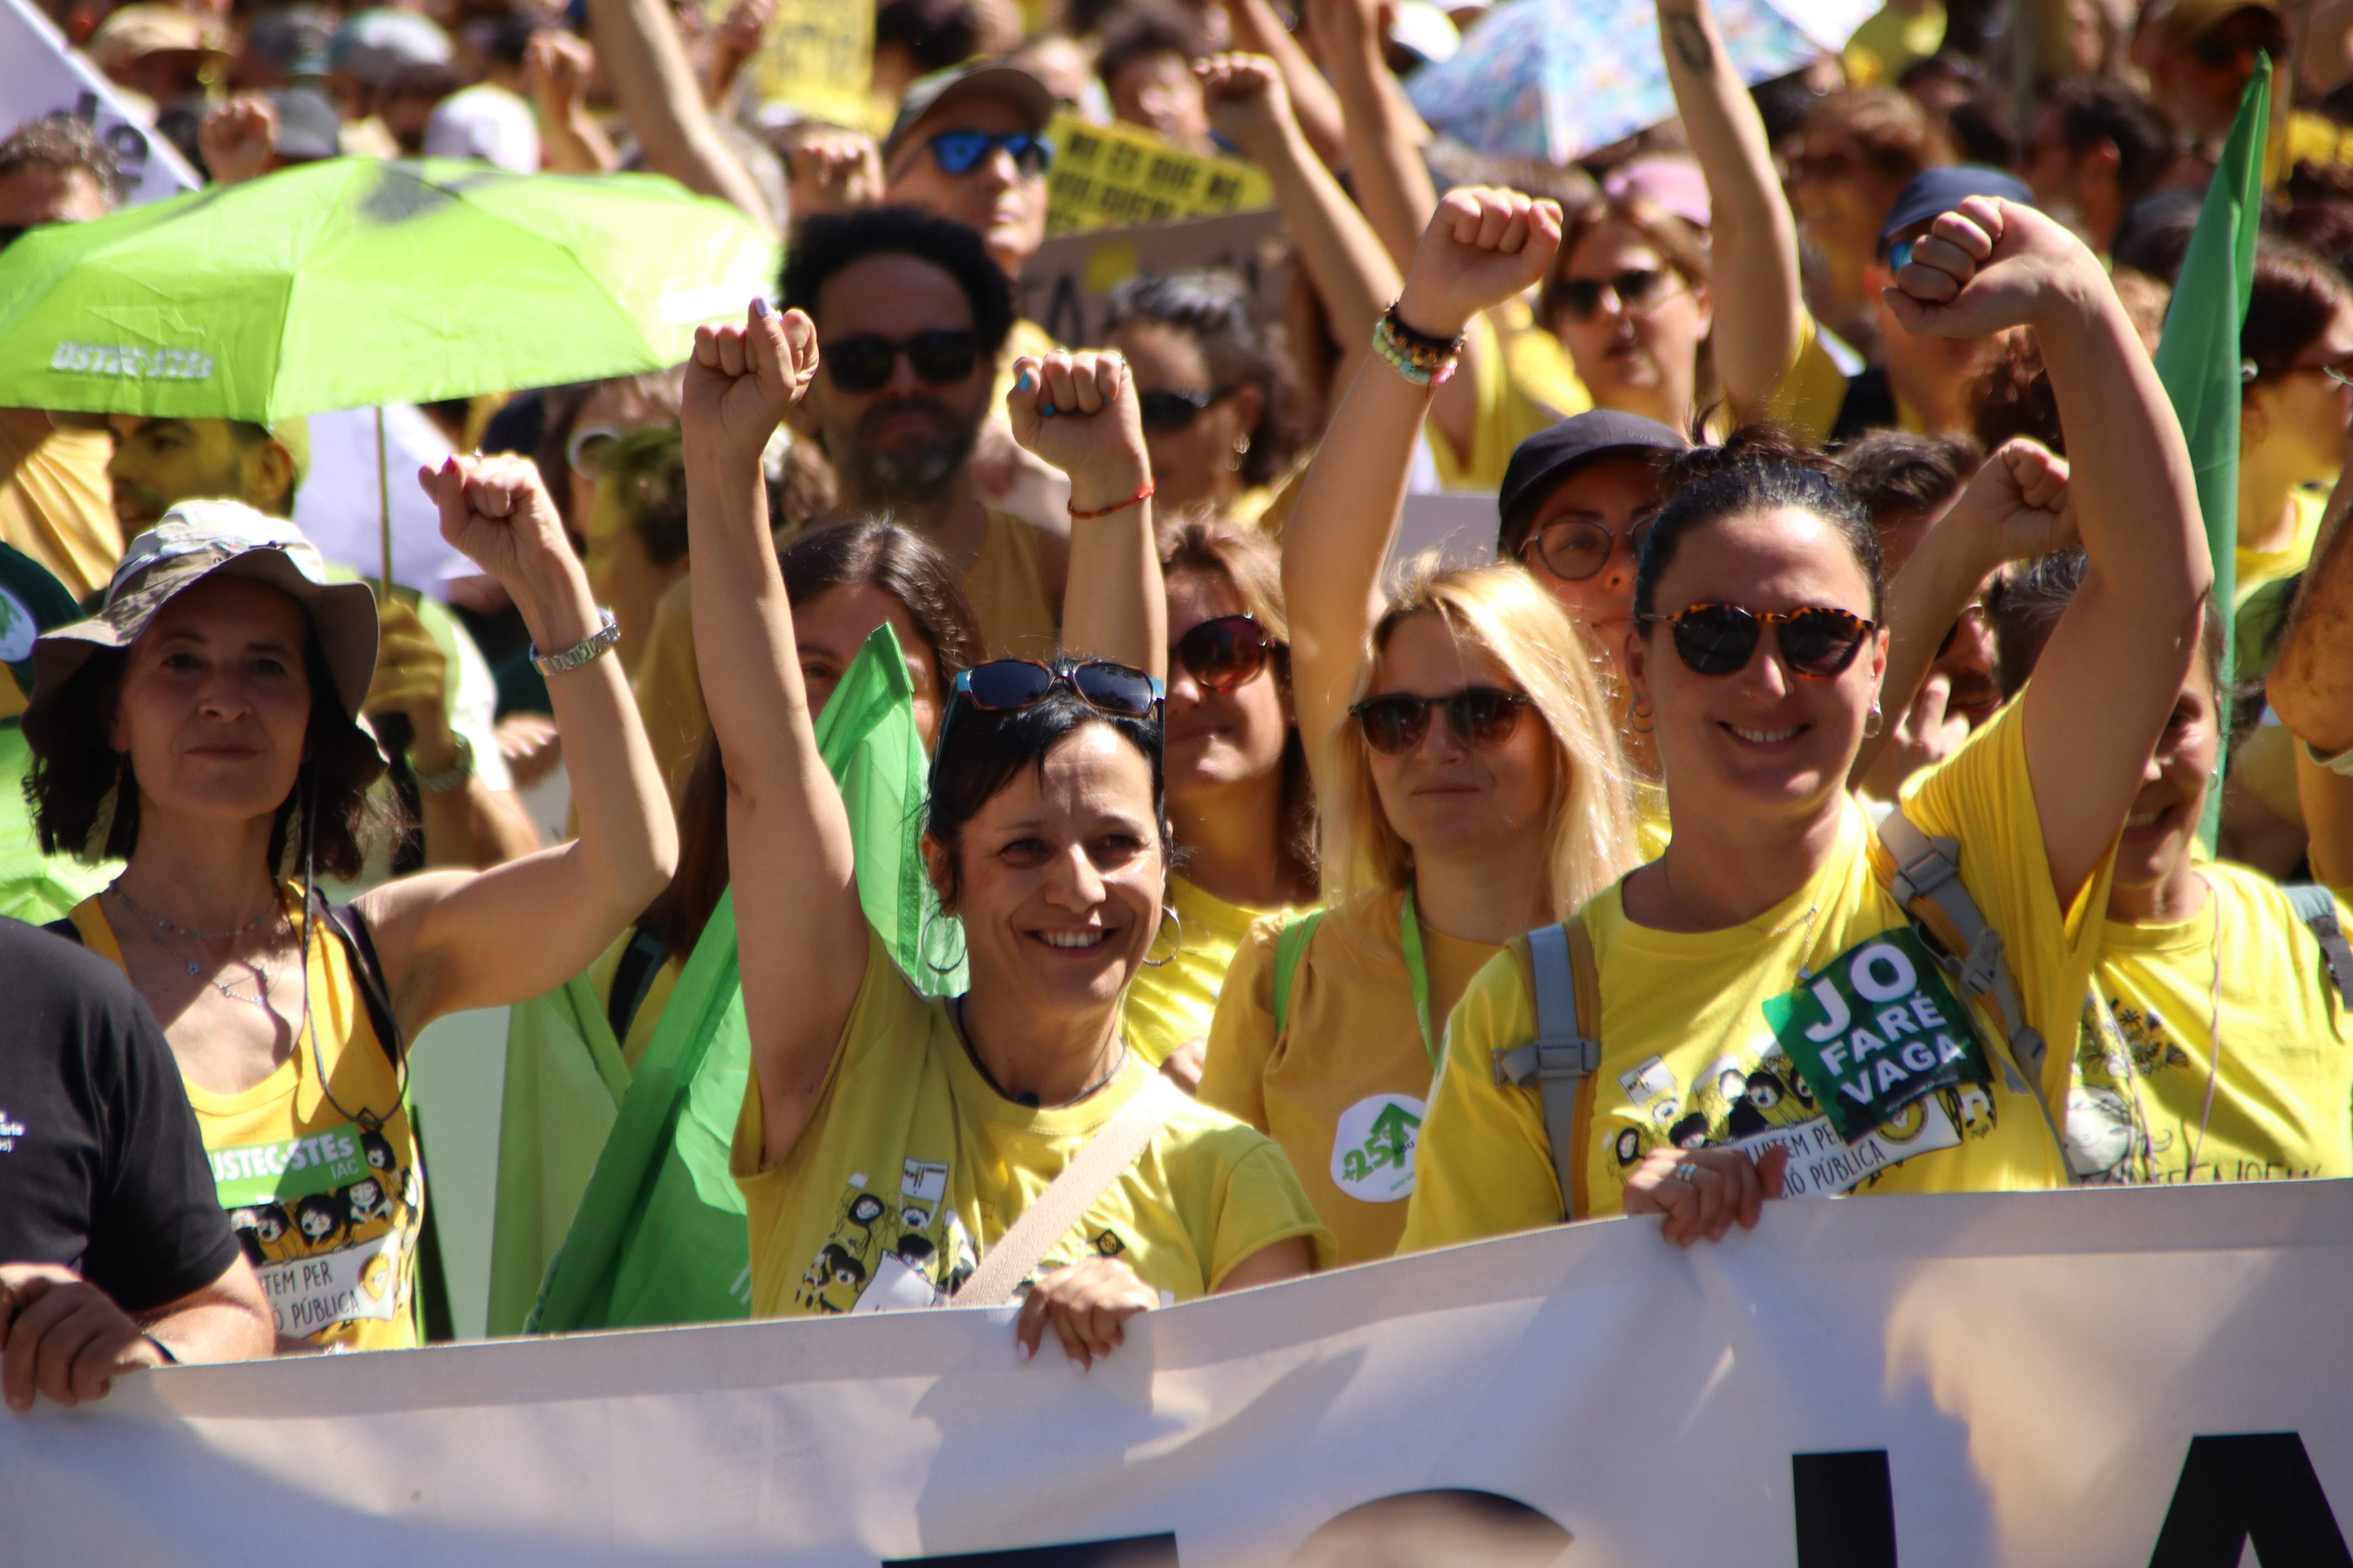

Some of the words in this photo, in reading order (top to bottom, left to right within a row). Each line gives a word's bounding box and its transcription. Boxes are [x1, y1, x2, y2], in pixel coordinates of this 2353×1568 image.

[1804, 942, 1918, 1043] JO
[1819, 990, 1948, 1078] FARÉ
[1840, 1033, 1967, 1105] VAGA
[330, 1159, 360, 1180] IAC
[1809, 1138, 1887, 1191] PÚBLICA
[259, 1268, 296, 1297] TEM
[302, 1261, 333, 1290] PER
[291, 1289, 361, 1330] PÚBLICA
